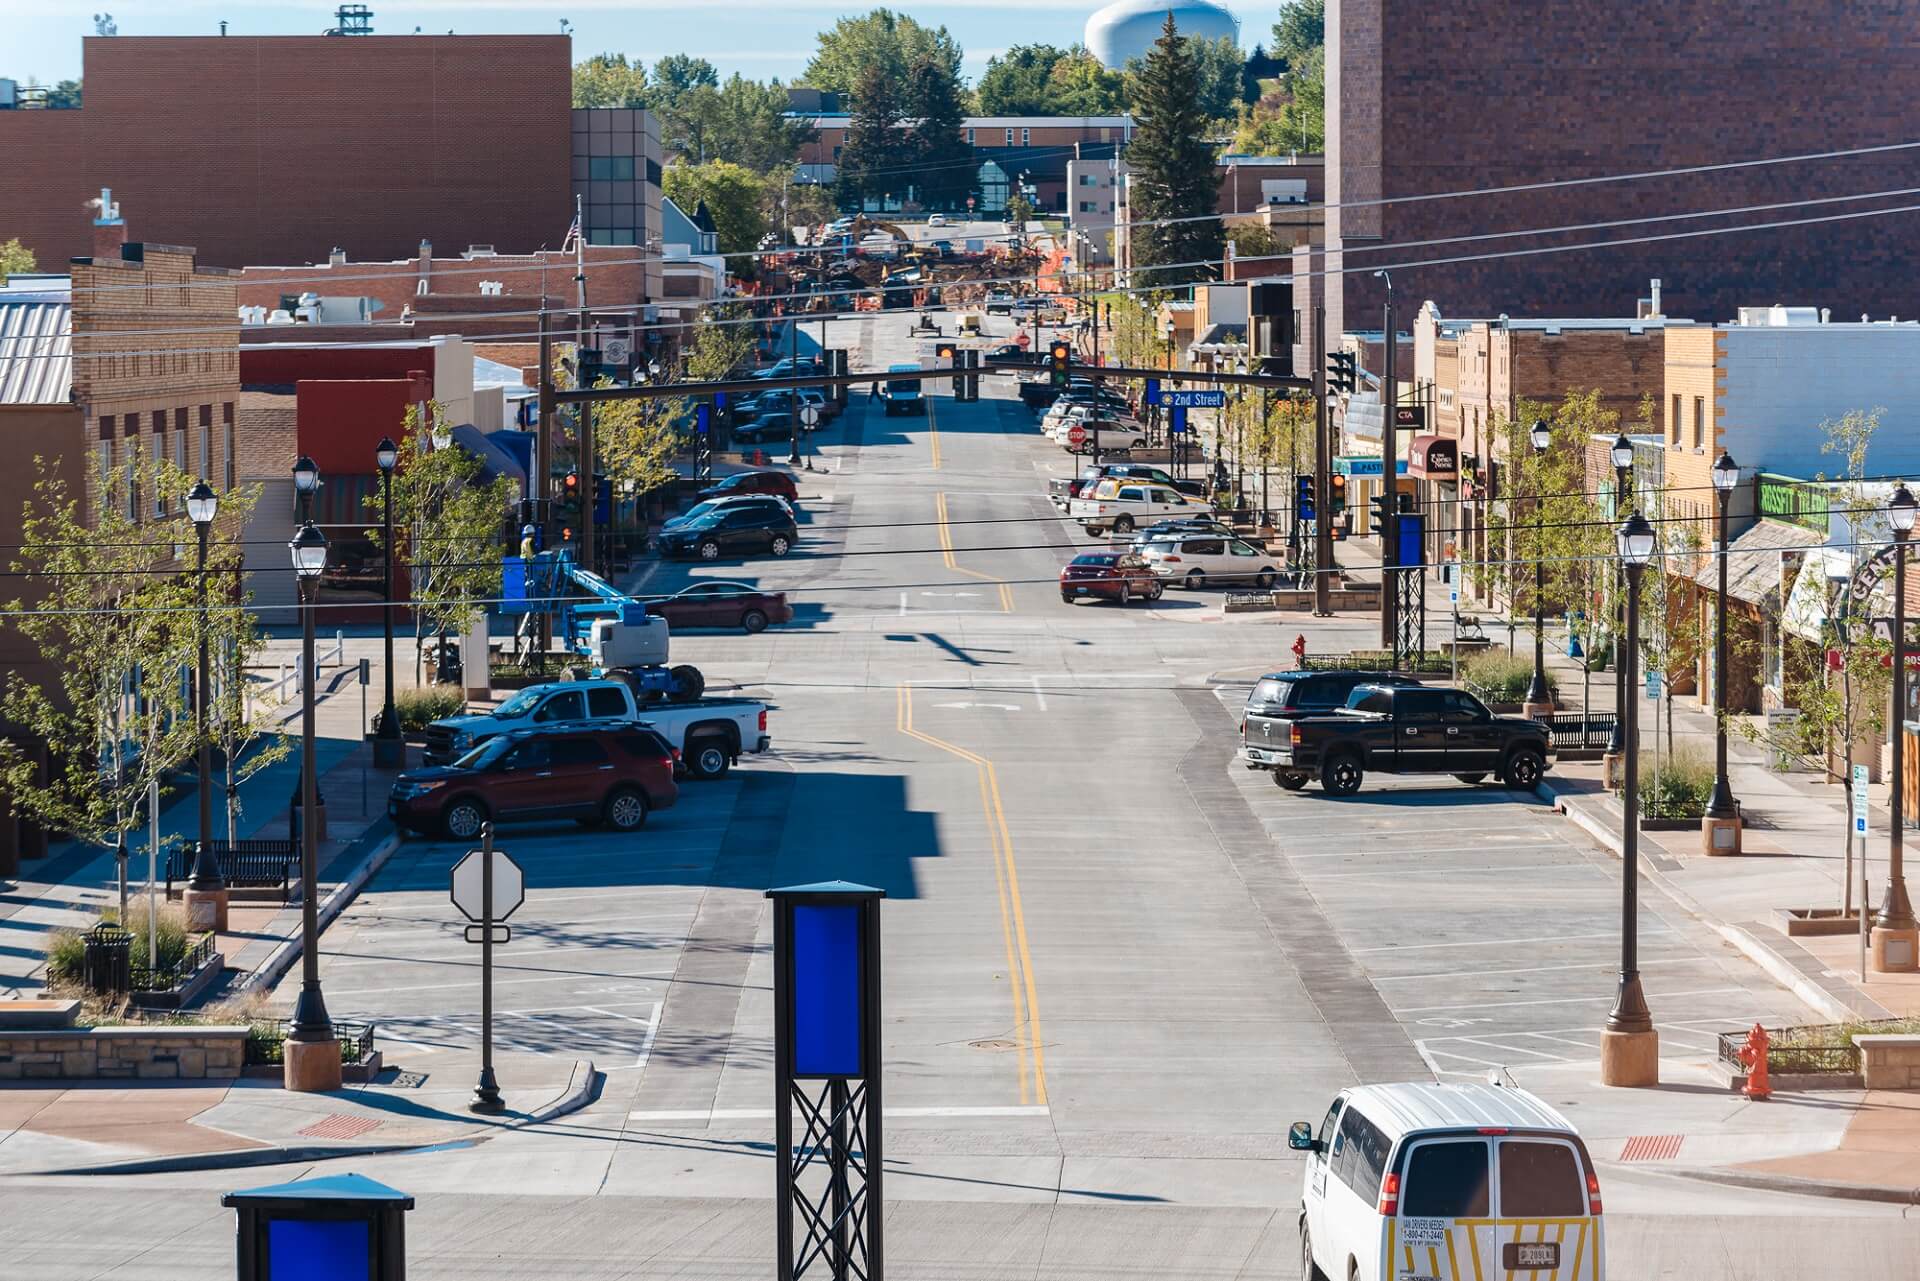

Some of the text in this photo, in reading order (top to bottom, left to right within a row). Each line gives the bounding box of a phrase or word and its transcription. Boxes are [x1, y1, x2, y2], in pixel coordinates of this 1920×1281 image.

[1175, 393, 1221, 406] 2nd Street
[1069, 431, 1085, 439] STOP
